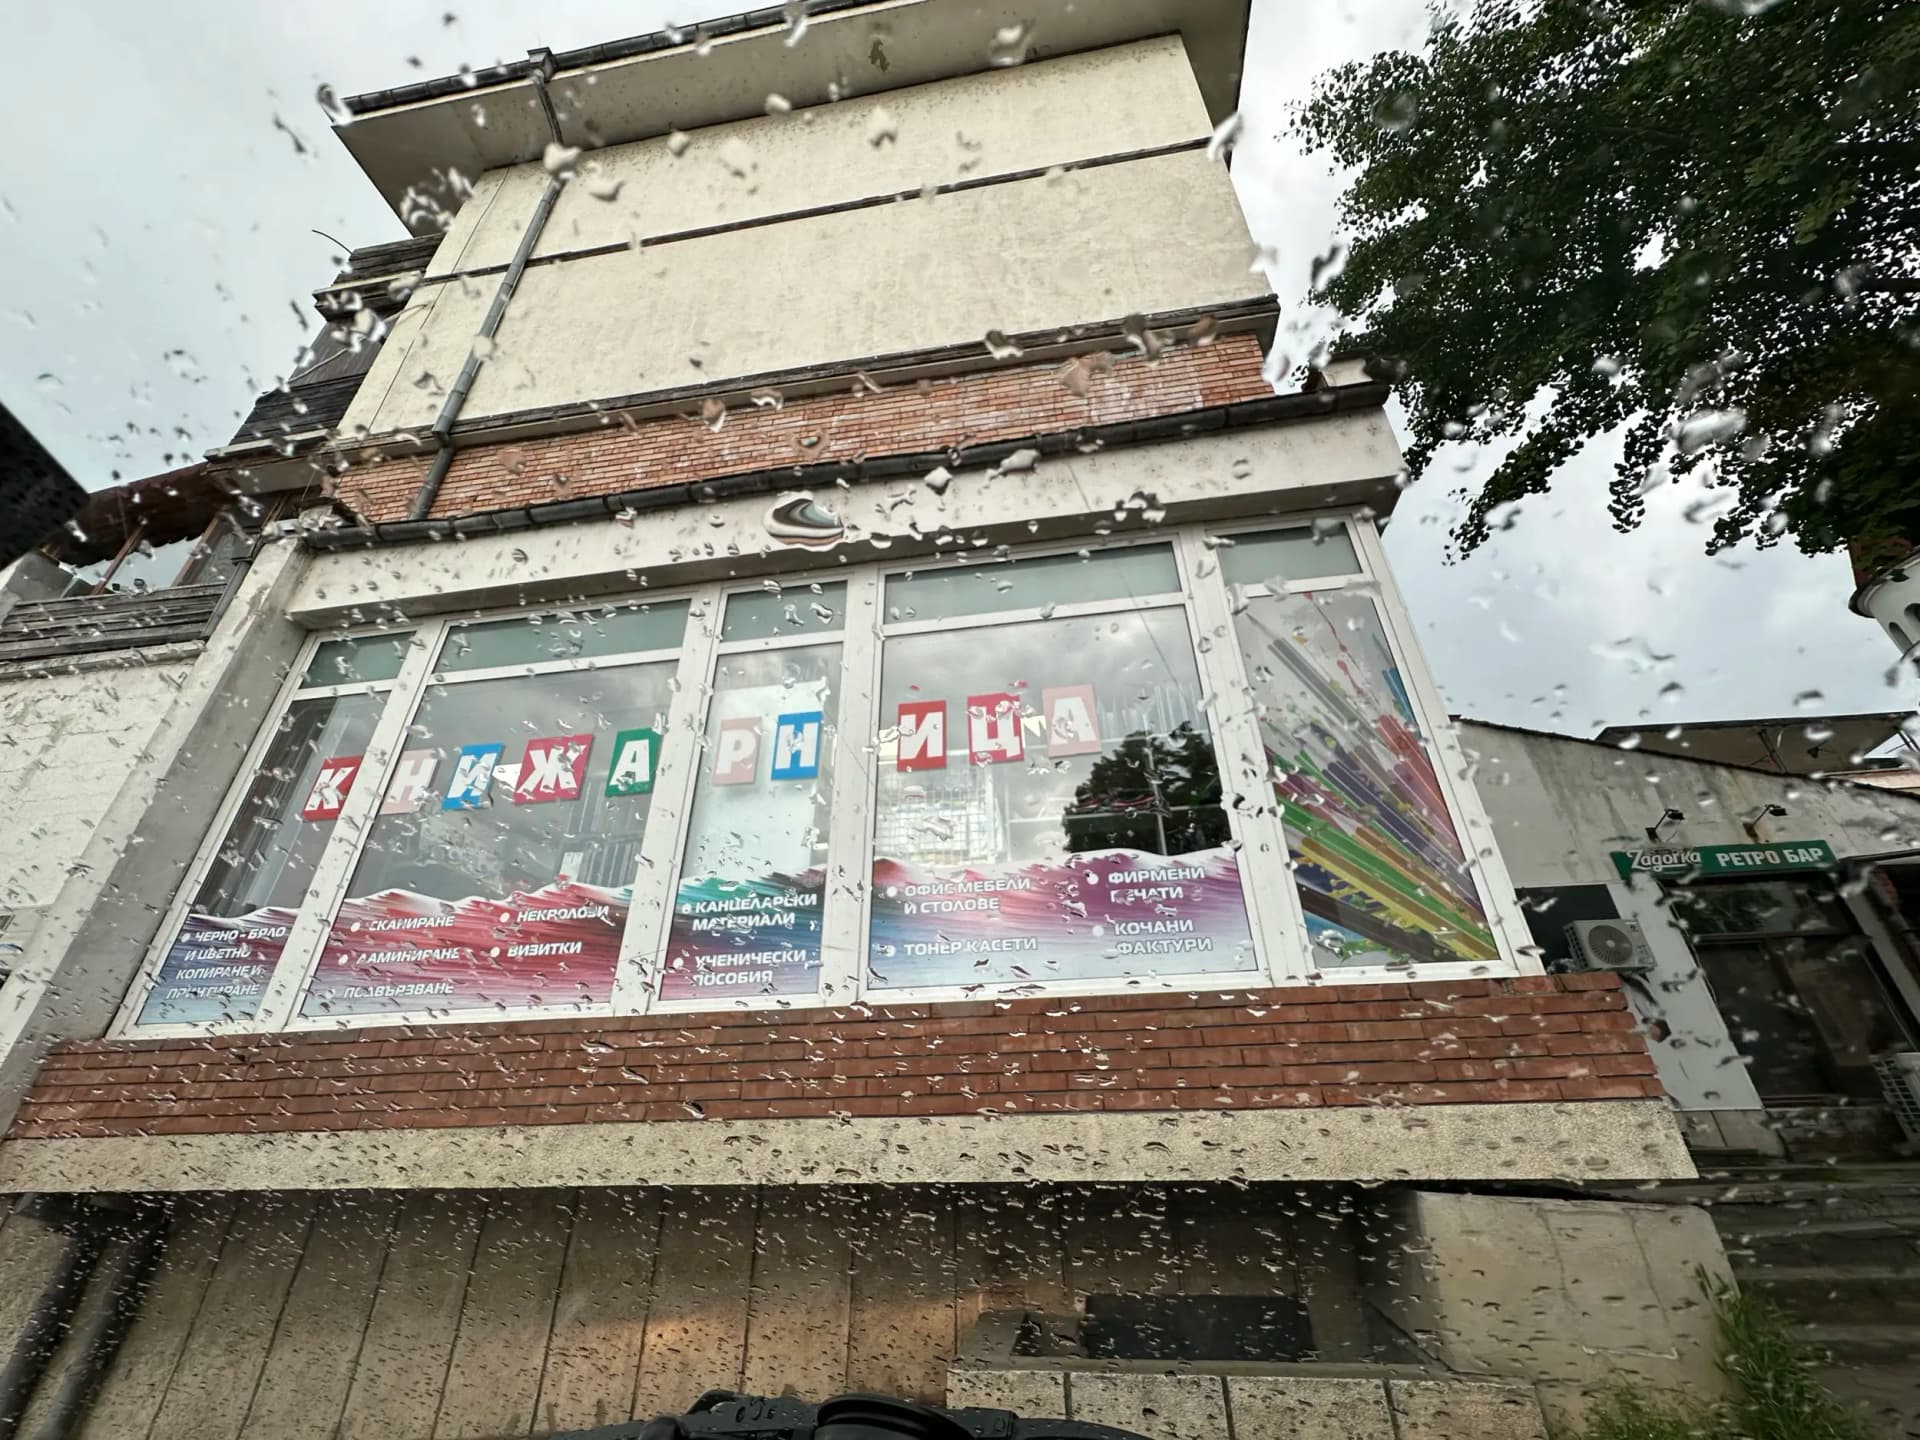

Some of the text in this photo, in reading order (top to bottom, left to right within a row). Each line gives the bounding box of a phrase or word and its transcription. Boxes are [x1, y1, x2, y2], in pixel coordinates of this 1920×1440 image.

[304, 697, 1098, 811] КНИЖАРНИЦА
[1717, 848, 1823, 867] РЕТРО БАР
[1108, 867, 1206, 884] ФИРМЕНИ
[904, 878, 1031, 897] ОФИС МЕБЕЛИ
[904, 898, 1000, 914] И СТОЛОВЕ
[368, 916, 456, 931] СКАНИРАНЕ
[1114, 919, 1194, 936] КОЧАНИ
[507, 941, 582, 957] ВИЗИТКИ
[904, 937, 1037, 956] ТОНЕР КАСЕТИ
[1116, 938, 1213, 955] ФАКТУРИ
[694, 950, 807, 969] УЧЕНИЧЕСКИ
[694, 970, 773, 986] ПОСОБИЯ
